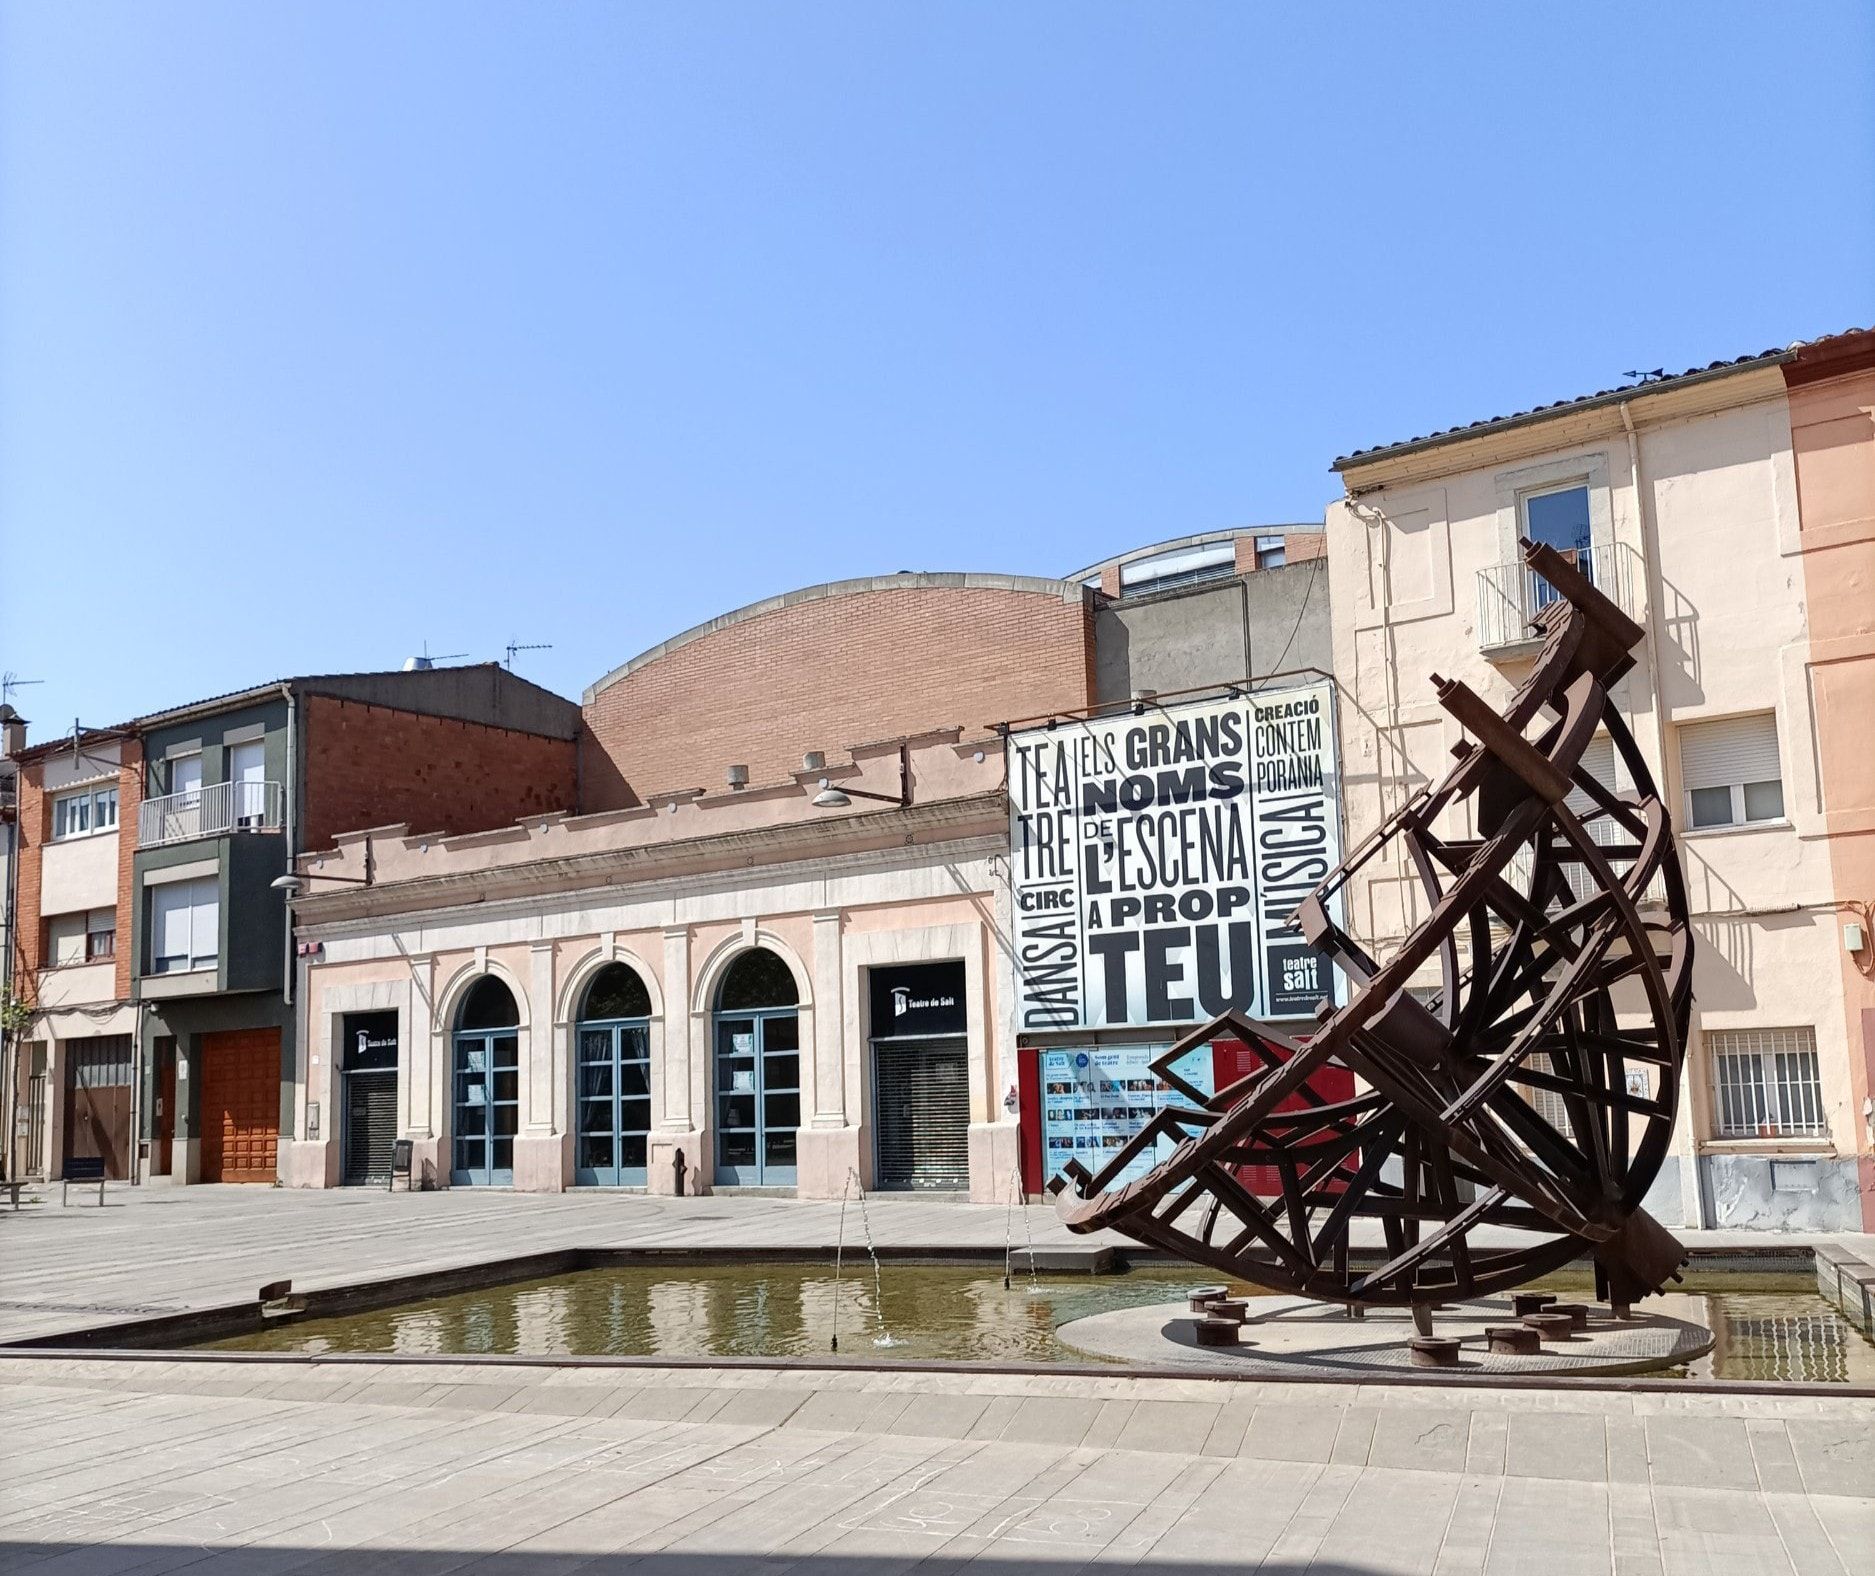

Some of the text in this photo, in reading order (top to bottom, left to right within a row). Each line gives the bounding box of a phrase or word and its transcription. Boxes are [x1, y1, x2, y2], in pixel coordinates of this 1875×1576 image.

[1254, 694, 1319, 722] CREACIÓ
[1082, 712, 1242, 778] ELS GRANS
[1255, 717, 1321, 758] CONTEM
[1016, 739, 1071, 811] TEA
[1083, 761, 1244, 816] NOMS
[1257, 753, 1323, 794] PORÀNIA
[1018, 809, 1073, 880] TRE
[1084, 819, 1112, 839] DE
[1020, 888, 1075, 911] CIRC
[1088, 887, 1250, 929] A PROP
[1022, 920, 1078, 1028] DANSA
[1088, 922, 1254, 1023] TEU
[1283, 957, 1317, 971] teatre
[1284, 969, 1318, 990] salt
[908, 997, 954, 1008] Teatre de Salt
